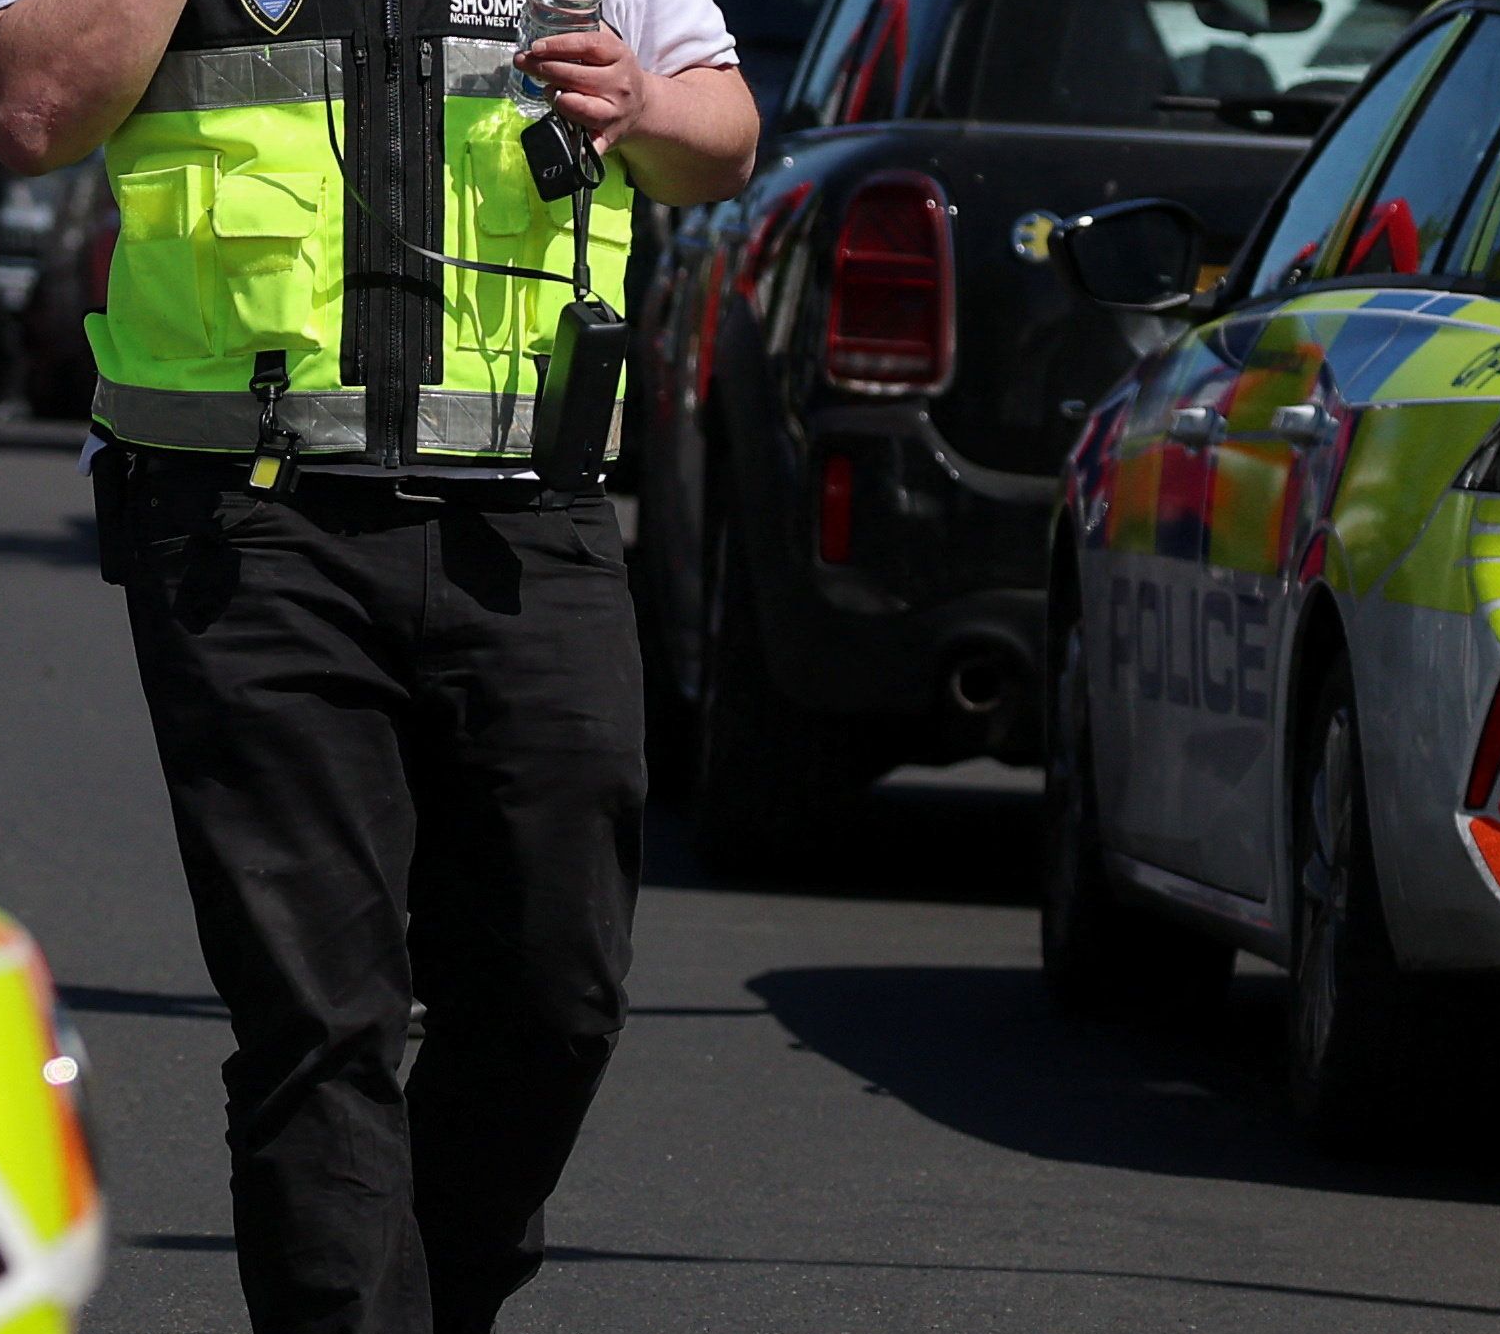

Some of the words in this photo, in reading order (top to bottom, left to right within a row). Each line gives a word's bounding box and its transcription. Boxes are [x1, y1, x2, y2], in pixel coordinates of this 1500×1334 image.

[450, 13, 482, 26] NORTH
[484, 16, 511, 28] WEST
[1110, 575, 1270, 722] POLICE
